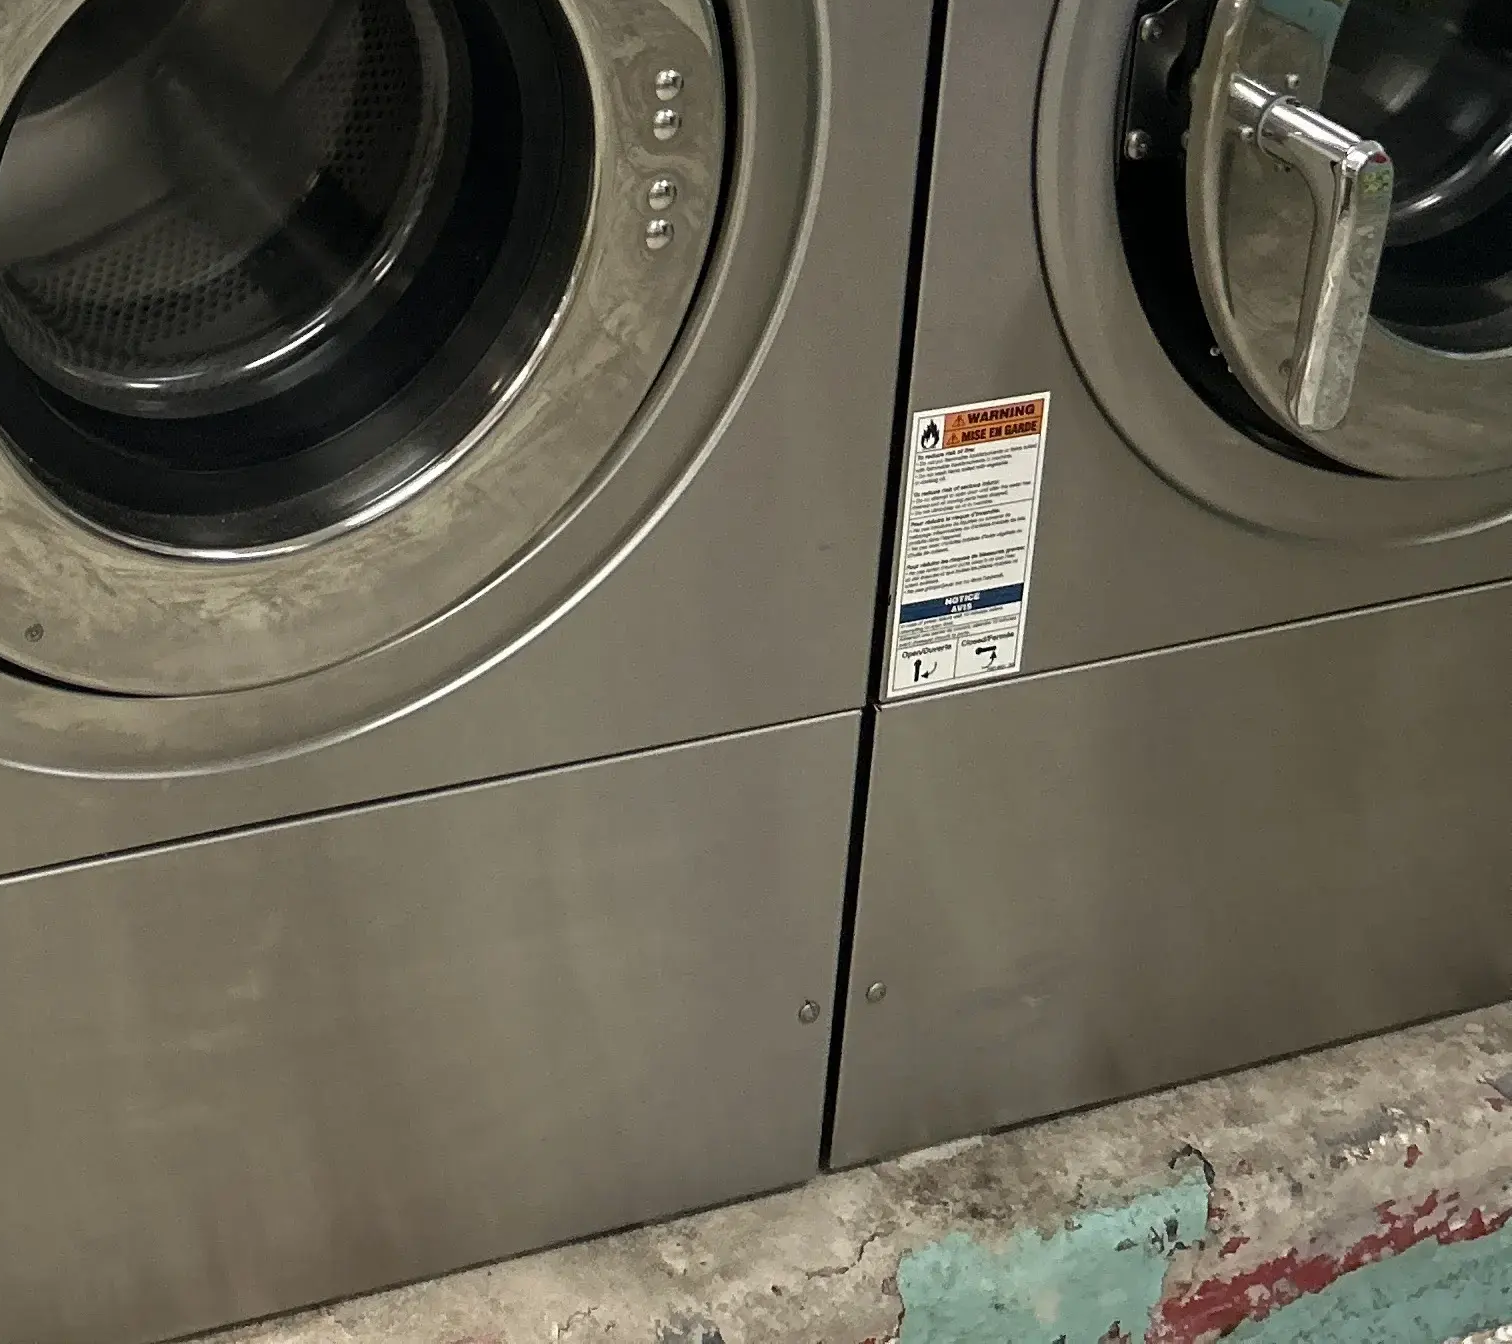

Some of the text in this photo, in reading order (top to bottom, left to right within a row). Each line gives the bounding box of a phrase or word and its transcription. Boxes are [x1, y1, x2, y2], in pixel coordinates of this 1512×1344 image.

[967, 403, 1035, 424] WARNING
[961, 420, 1037, 443] MISE EN GARDE
[944, 592, 981, 606] NOTICE
[950, 602, 973, 614] AVIS
